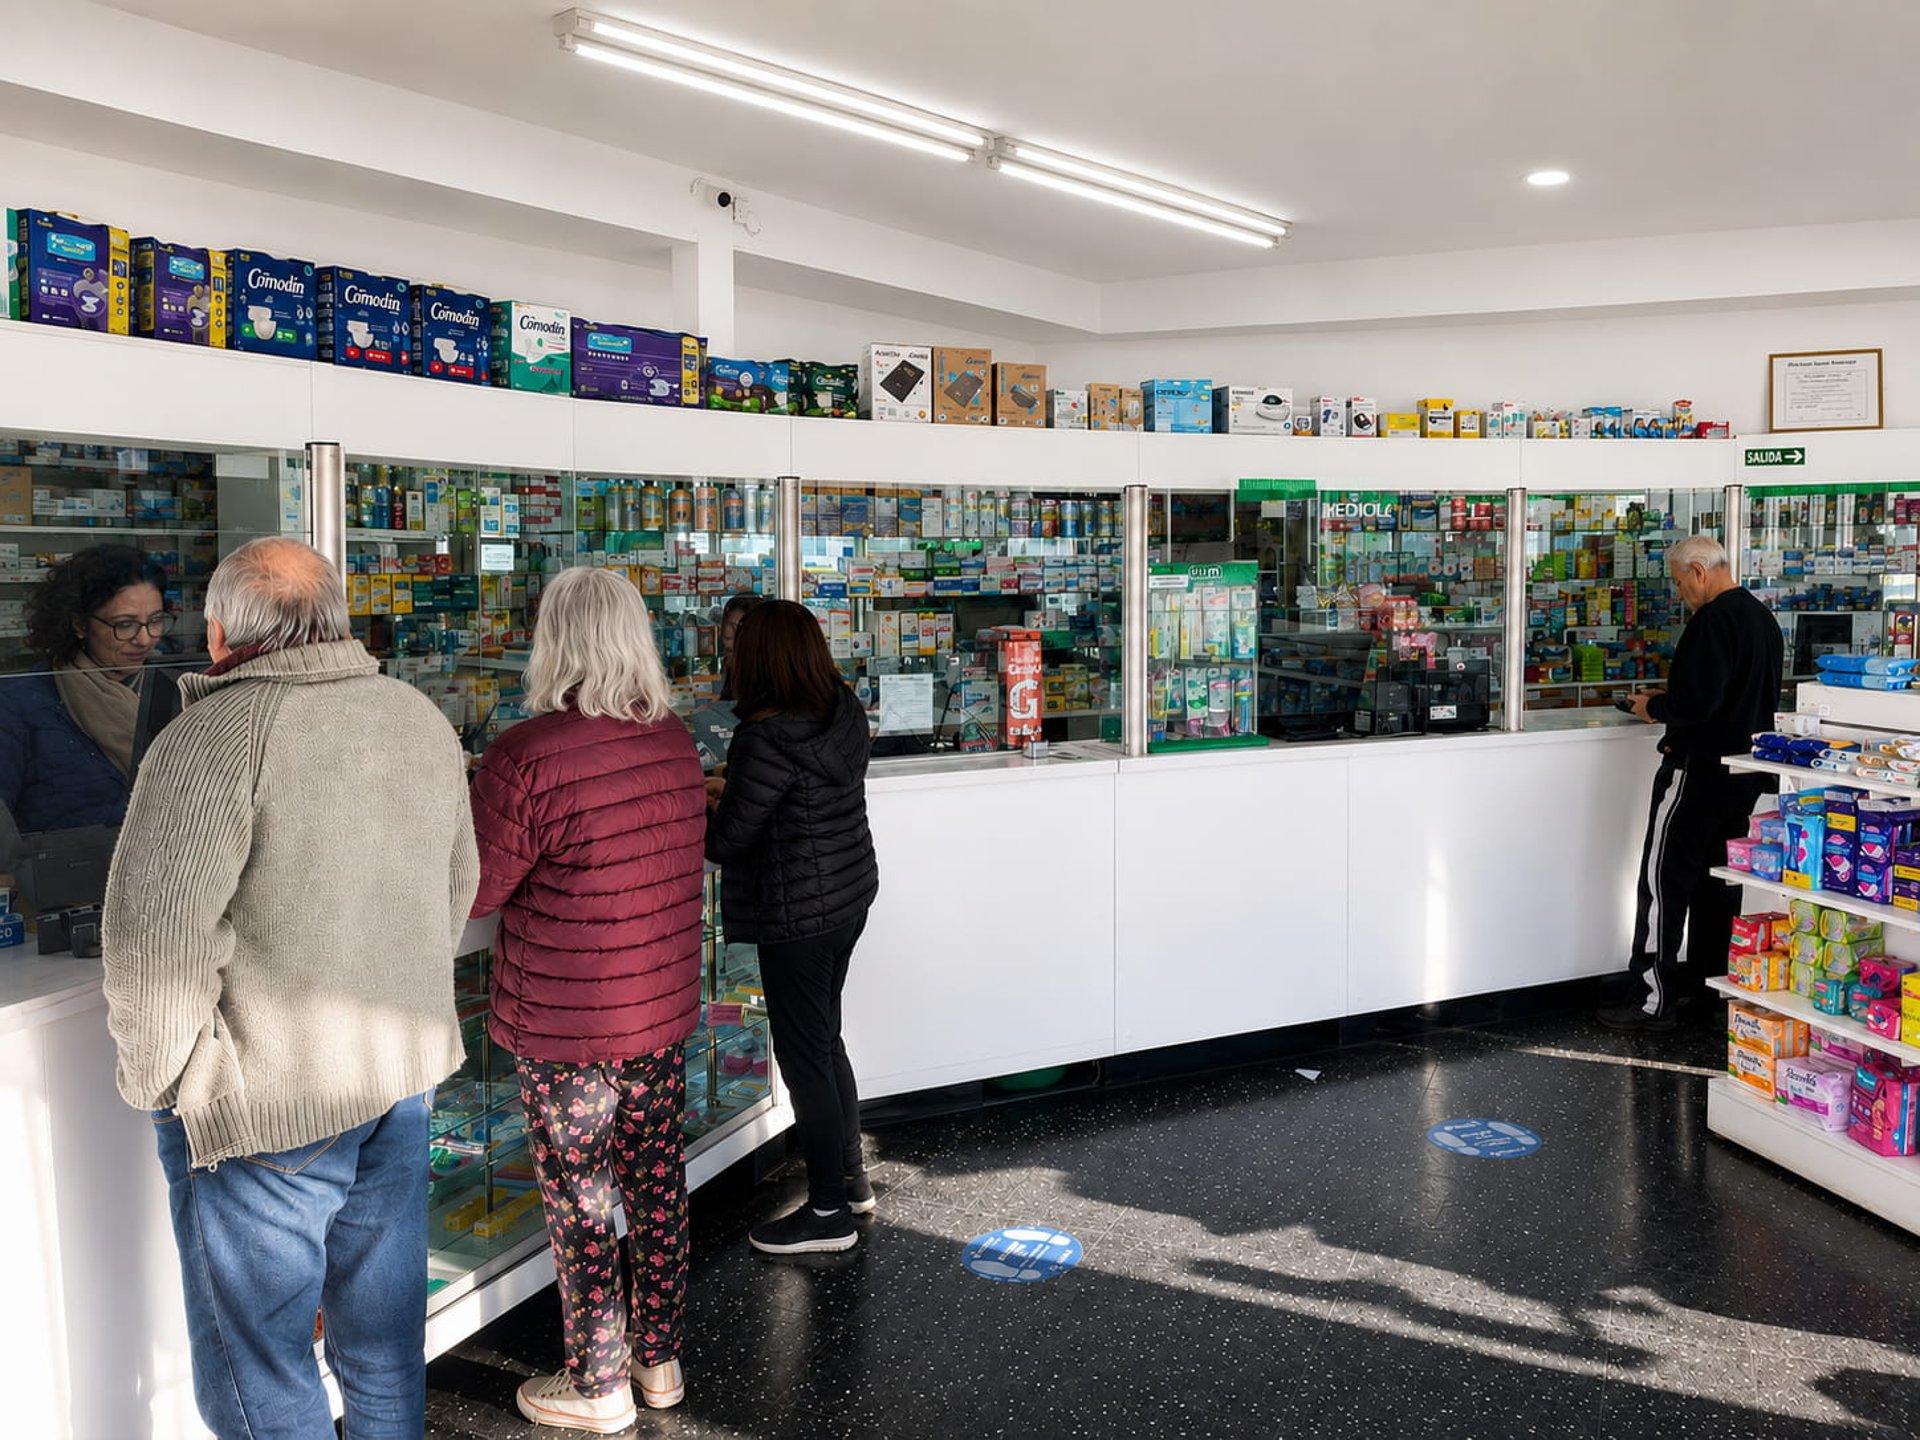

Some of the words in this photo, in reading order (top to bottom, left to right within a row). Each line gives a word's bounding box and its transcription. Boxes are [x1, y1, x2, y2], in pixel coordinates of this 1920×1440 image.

[248, 268, 305, 294] Comodin
[345, 285, 400, 311] Comodin
[431, 302, 479, 327] Comodin
[1747, 451, 1782, 463] SALIDA
